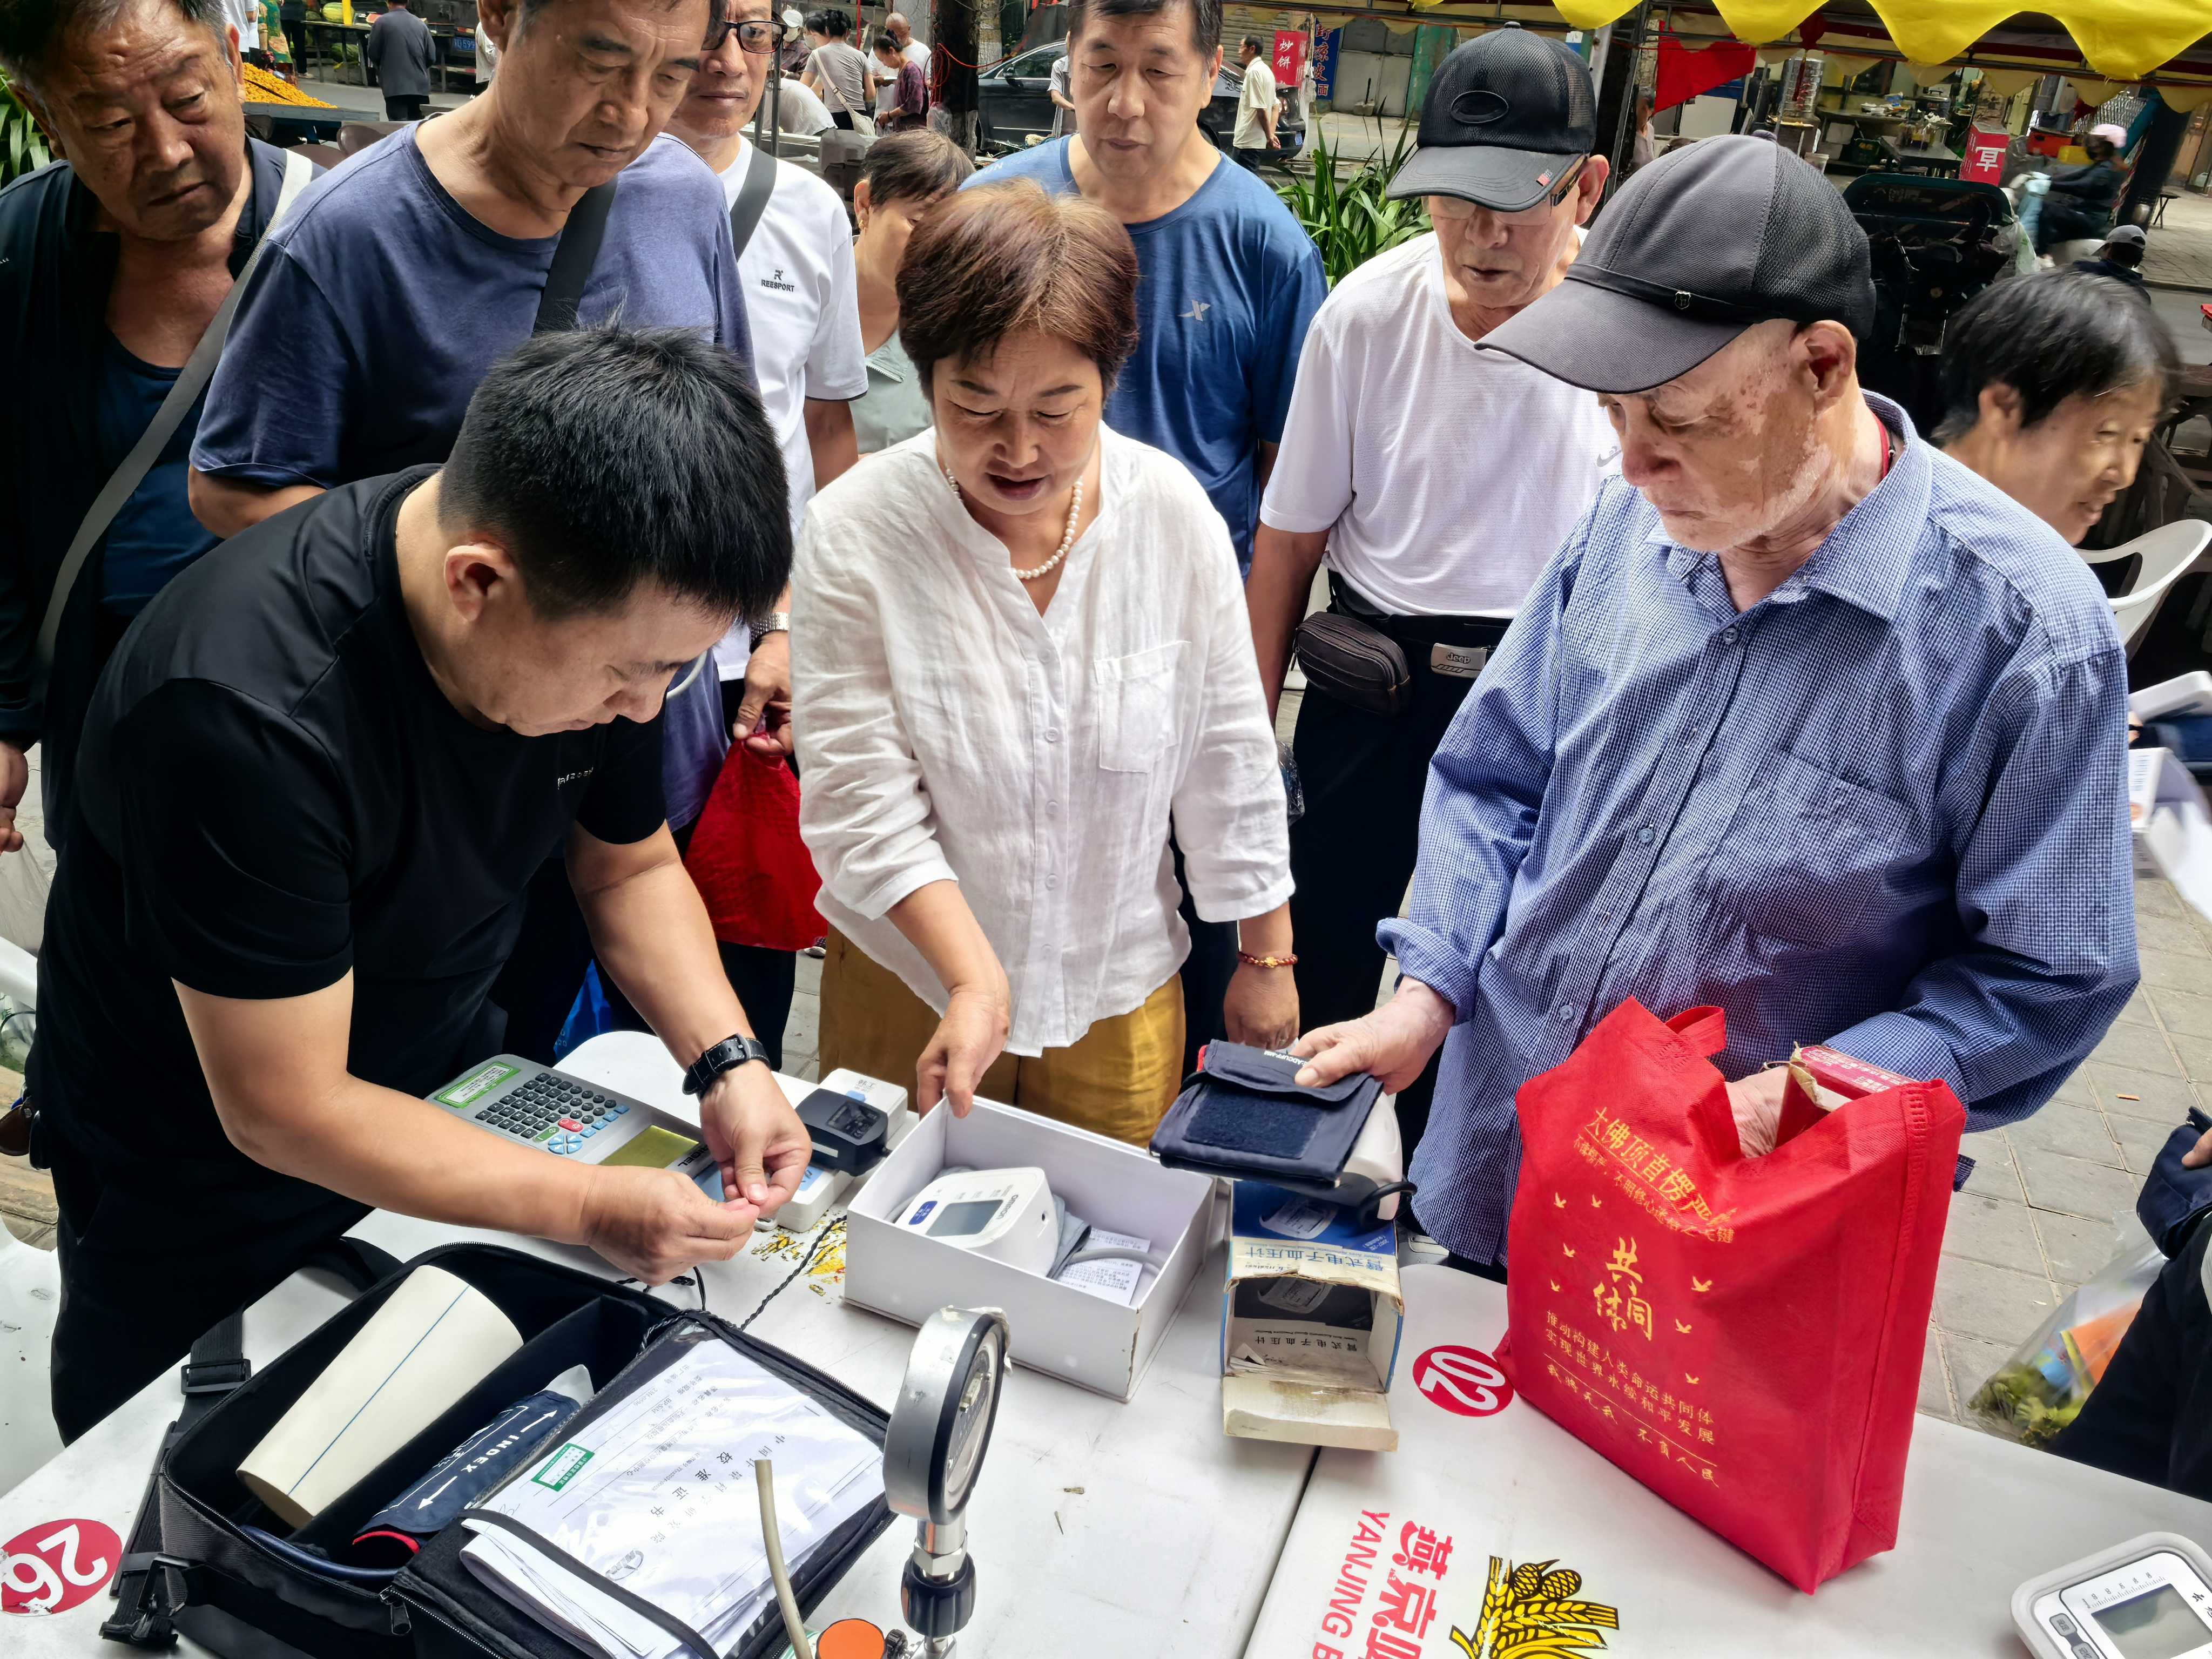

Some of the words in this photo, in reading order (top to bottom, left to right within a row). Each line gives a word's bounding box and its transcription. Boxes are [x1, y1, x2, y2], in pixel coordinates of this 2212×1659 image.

[761, 279, 795, 293] REESPORT
[1446, 652, 1471, 665] Jeep
[1246, 1246, 1383, 1272] 臂式电子血压计
[1419, 1352, 1505, 1412] 02
[1547, 1310, 1714, 1425] 推动构建人类命运共同体
[461, 1434, 520, 1473] INDEX
[651, 1452, 733, 1518] 校准证书
[1321, 1509, 1391, 1639] YANJING
